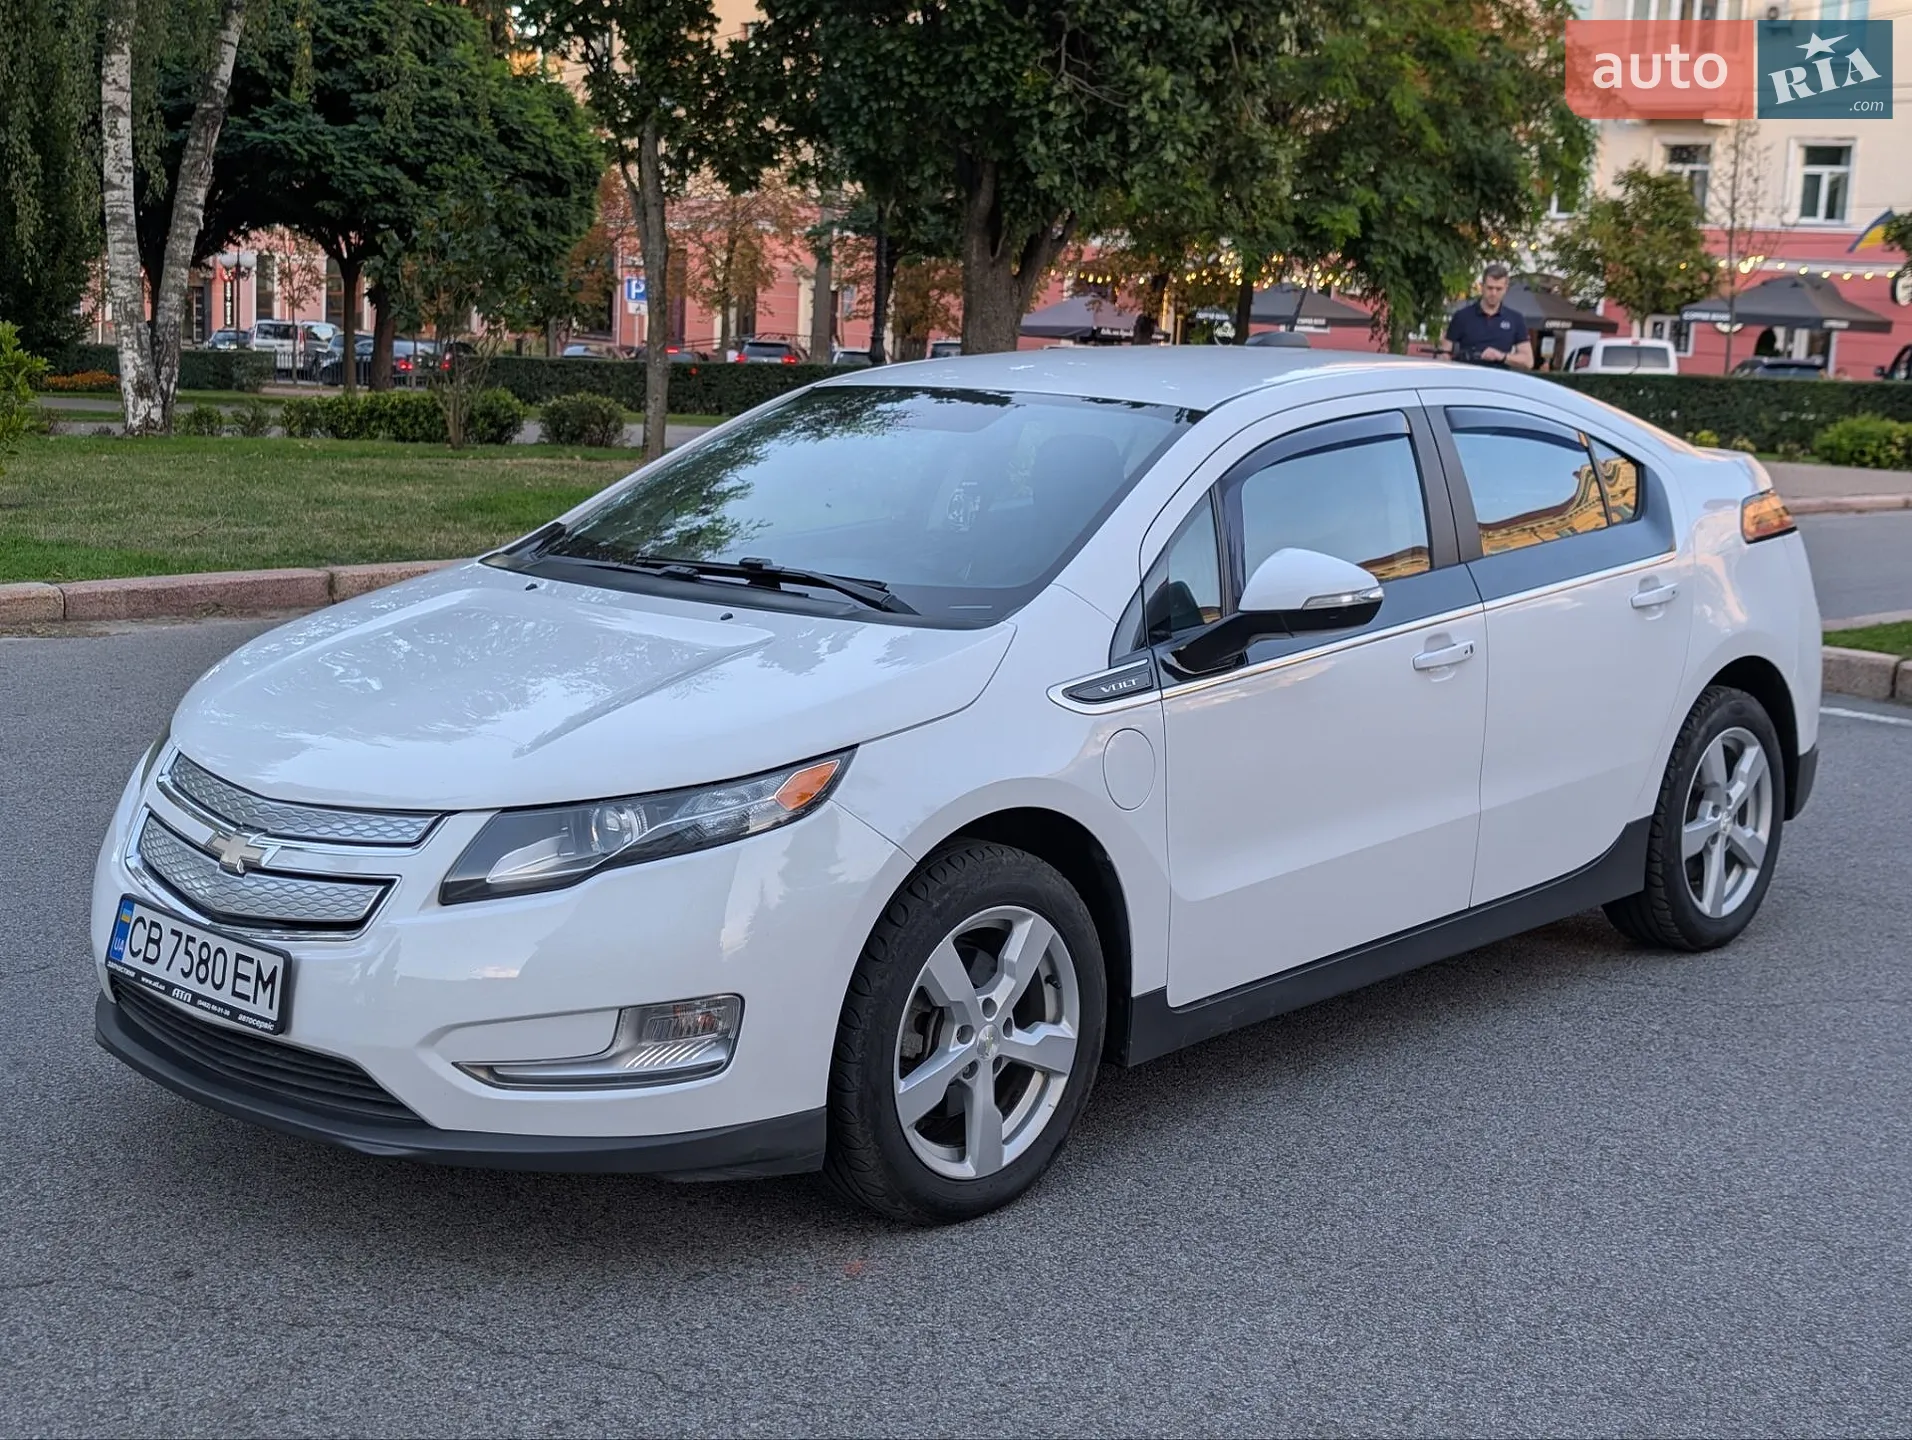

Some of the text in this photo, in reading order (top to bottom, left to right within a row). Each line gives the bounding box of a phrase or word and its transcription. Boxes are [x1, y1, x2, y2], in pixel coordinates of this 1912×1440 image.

[630, 279, 646, 299] P
[1100, 678, 1140, 693] VOLT
[113, 937, 125, 954] UA
[128, 915, 278, 1011] CB 7580 EM
